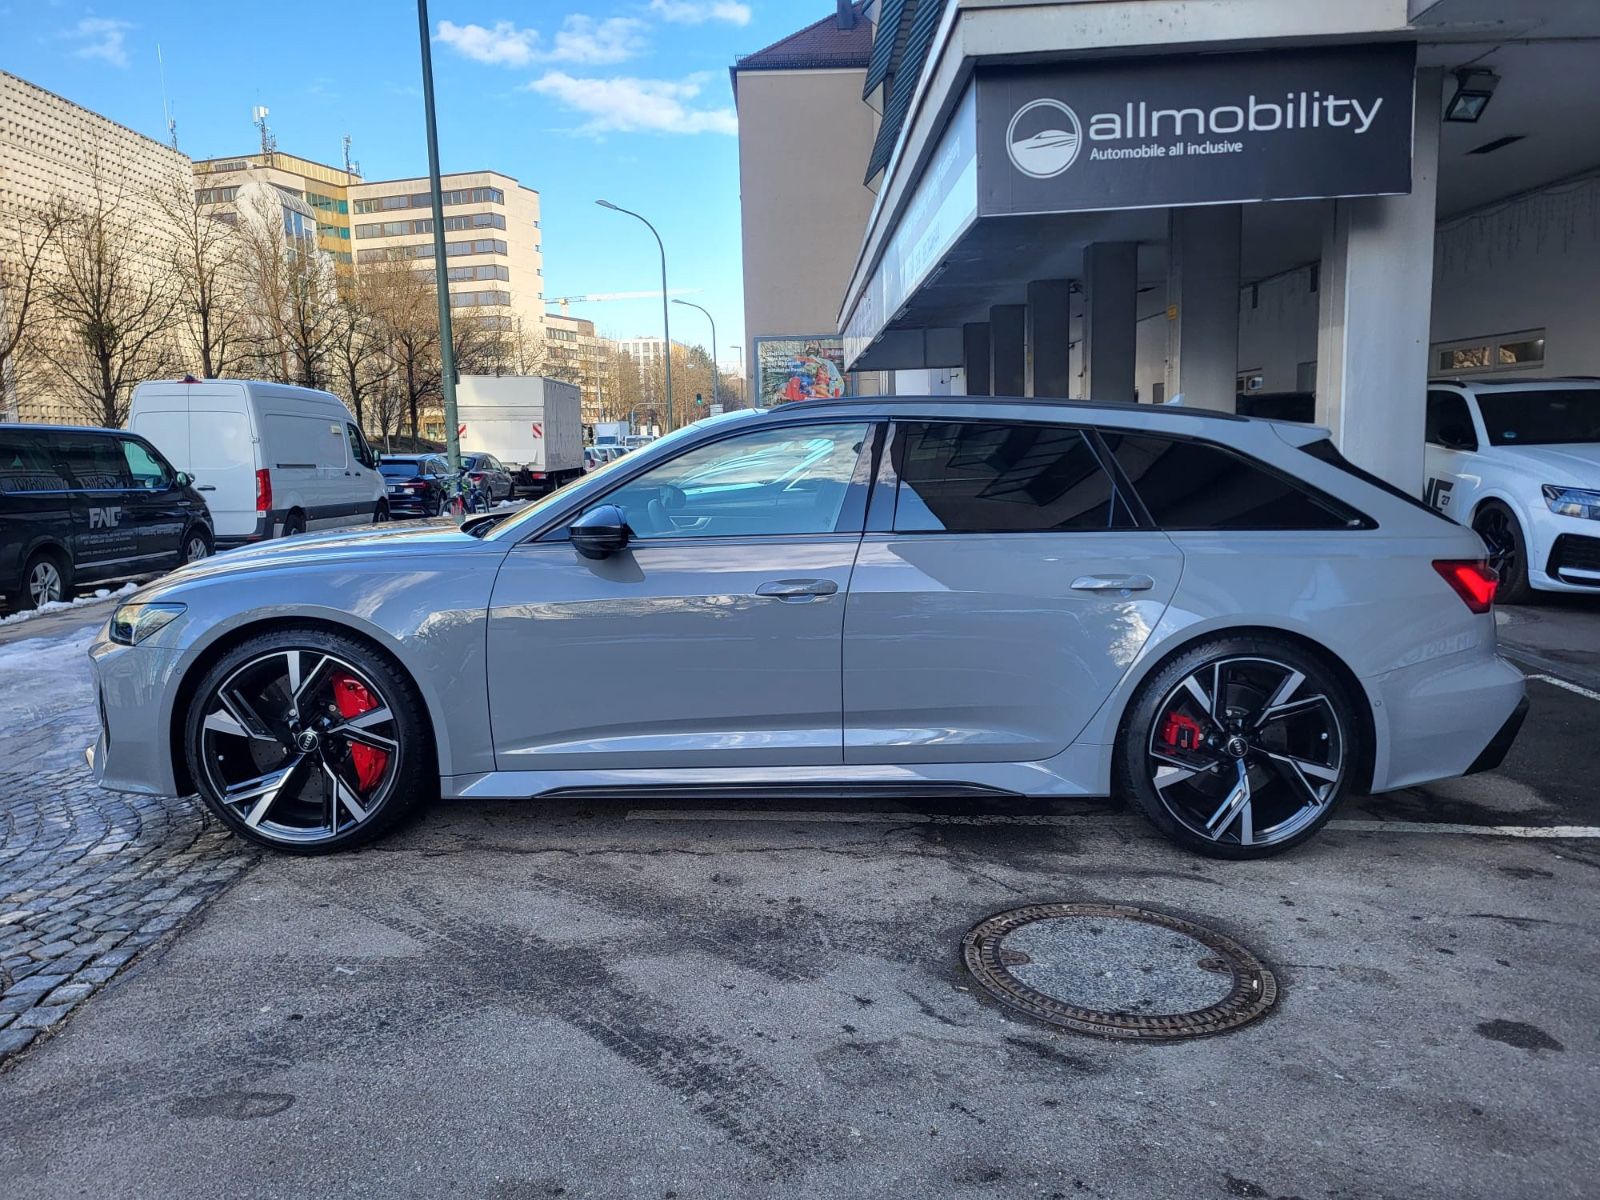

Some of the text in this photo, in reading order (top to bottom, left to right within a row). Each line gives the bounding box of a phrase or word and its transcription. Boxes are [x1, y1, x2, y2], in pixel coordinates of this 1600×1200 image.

[1088, 91, 1383, 140] allmobility
[1089, 140, 1244, 161] Automobile all inclusive
